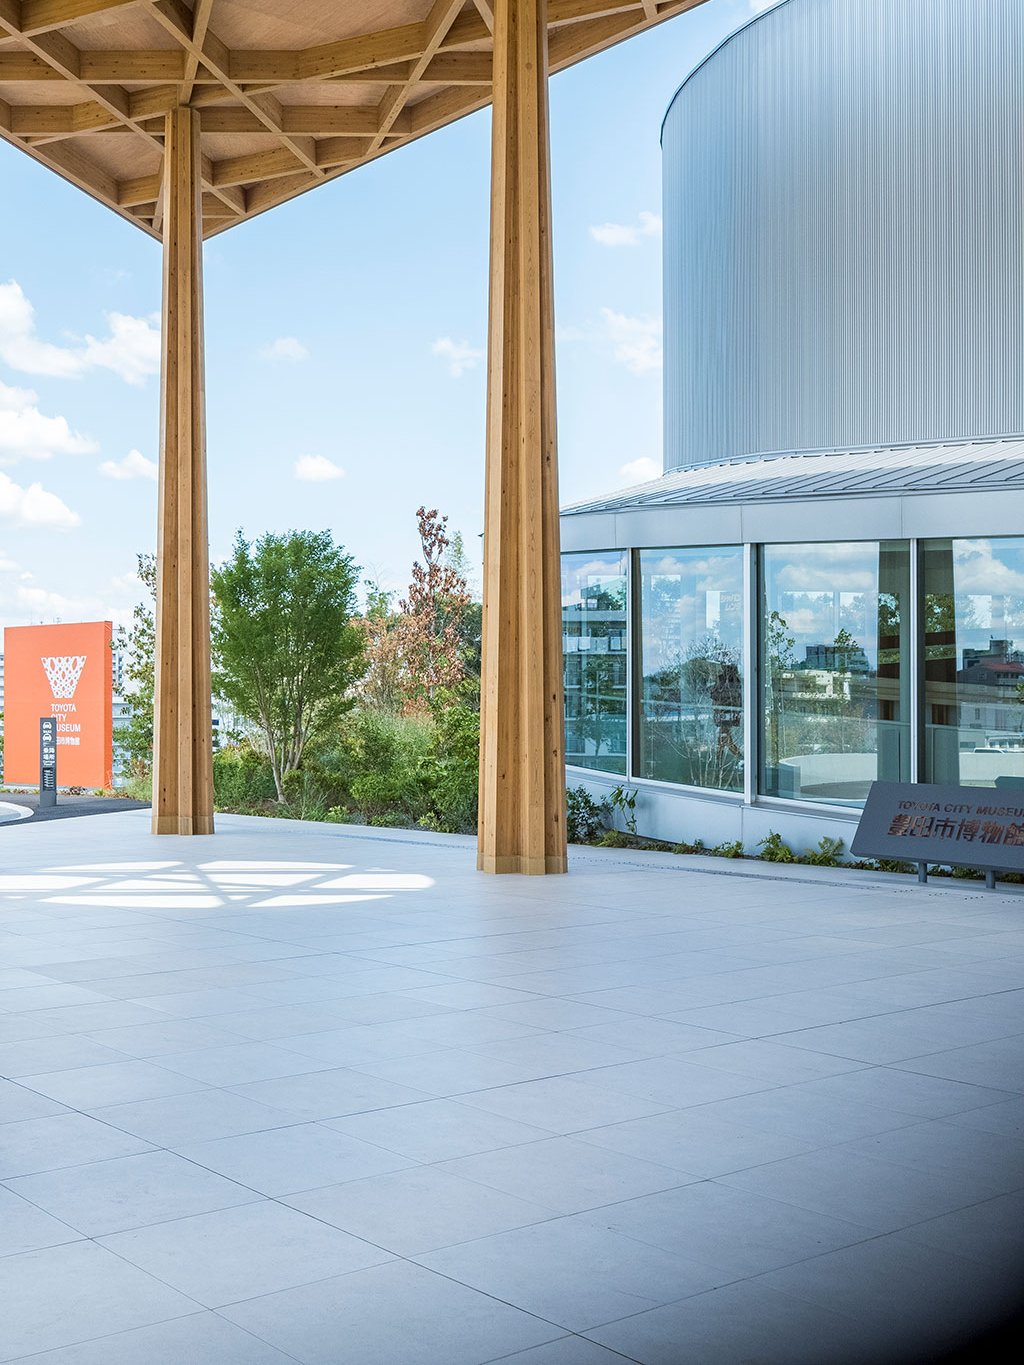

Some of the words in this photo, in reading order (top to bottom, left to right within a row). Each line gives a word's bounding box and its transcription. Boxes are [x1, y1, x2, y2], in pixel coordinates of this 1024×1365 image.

[50, 704, 76, 712] TOYOTA
[56, 724, 80, 732] USEUM
[897, 800, 941, 812] TOYOTA
[943, 803, 974, 814] CITY
[976, 806, 1024, 818] MUSEU
[887, 813, 1024, 846] 豊田市博物館
